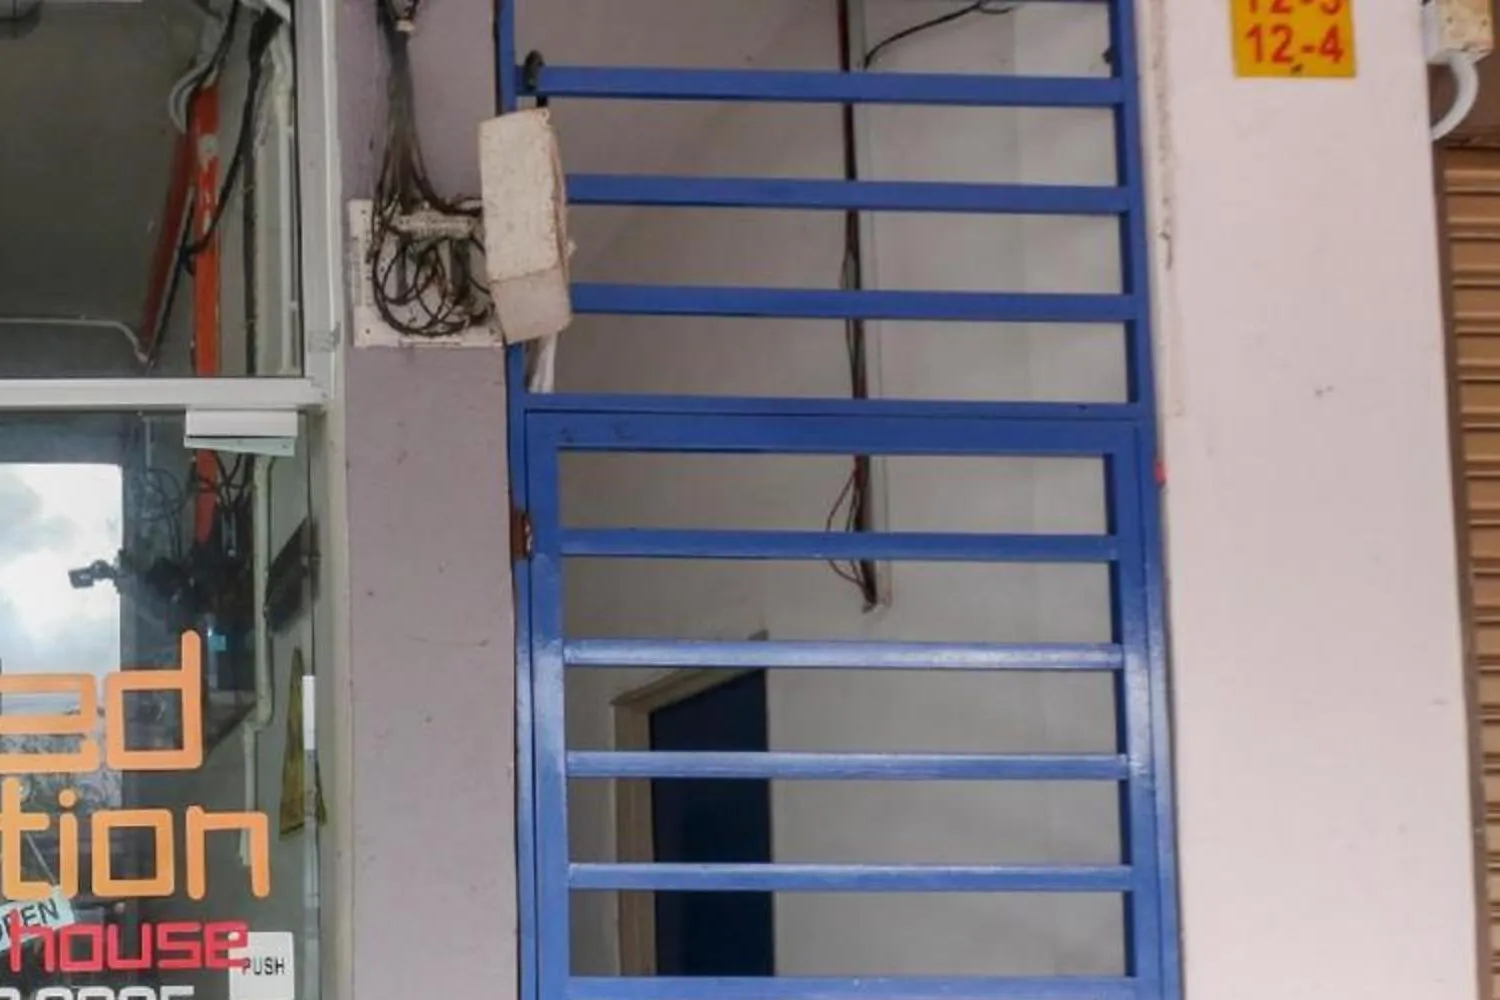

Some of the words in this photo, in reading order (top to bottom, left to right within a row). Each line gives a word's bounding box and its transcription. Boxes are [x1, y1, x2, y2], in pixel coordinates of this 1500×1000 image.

[1245, 22, 1344, 63] 12-4
[9, 908, 251, 974] house
[241, 956, 286, 976] PUSH
